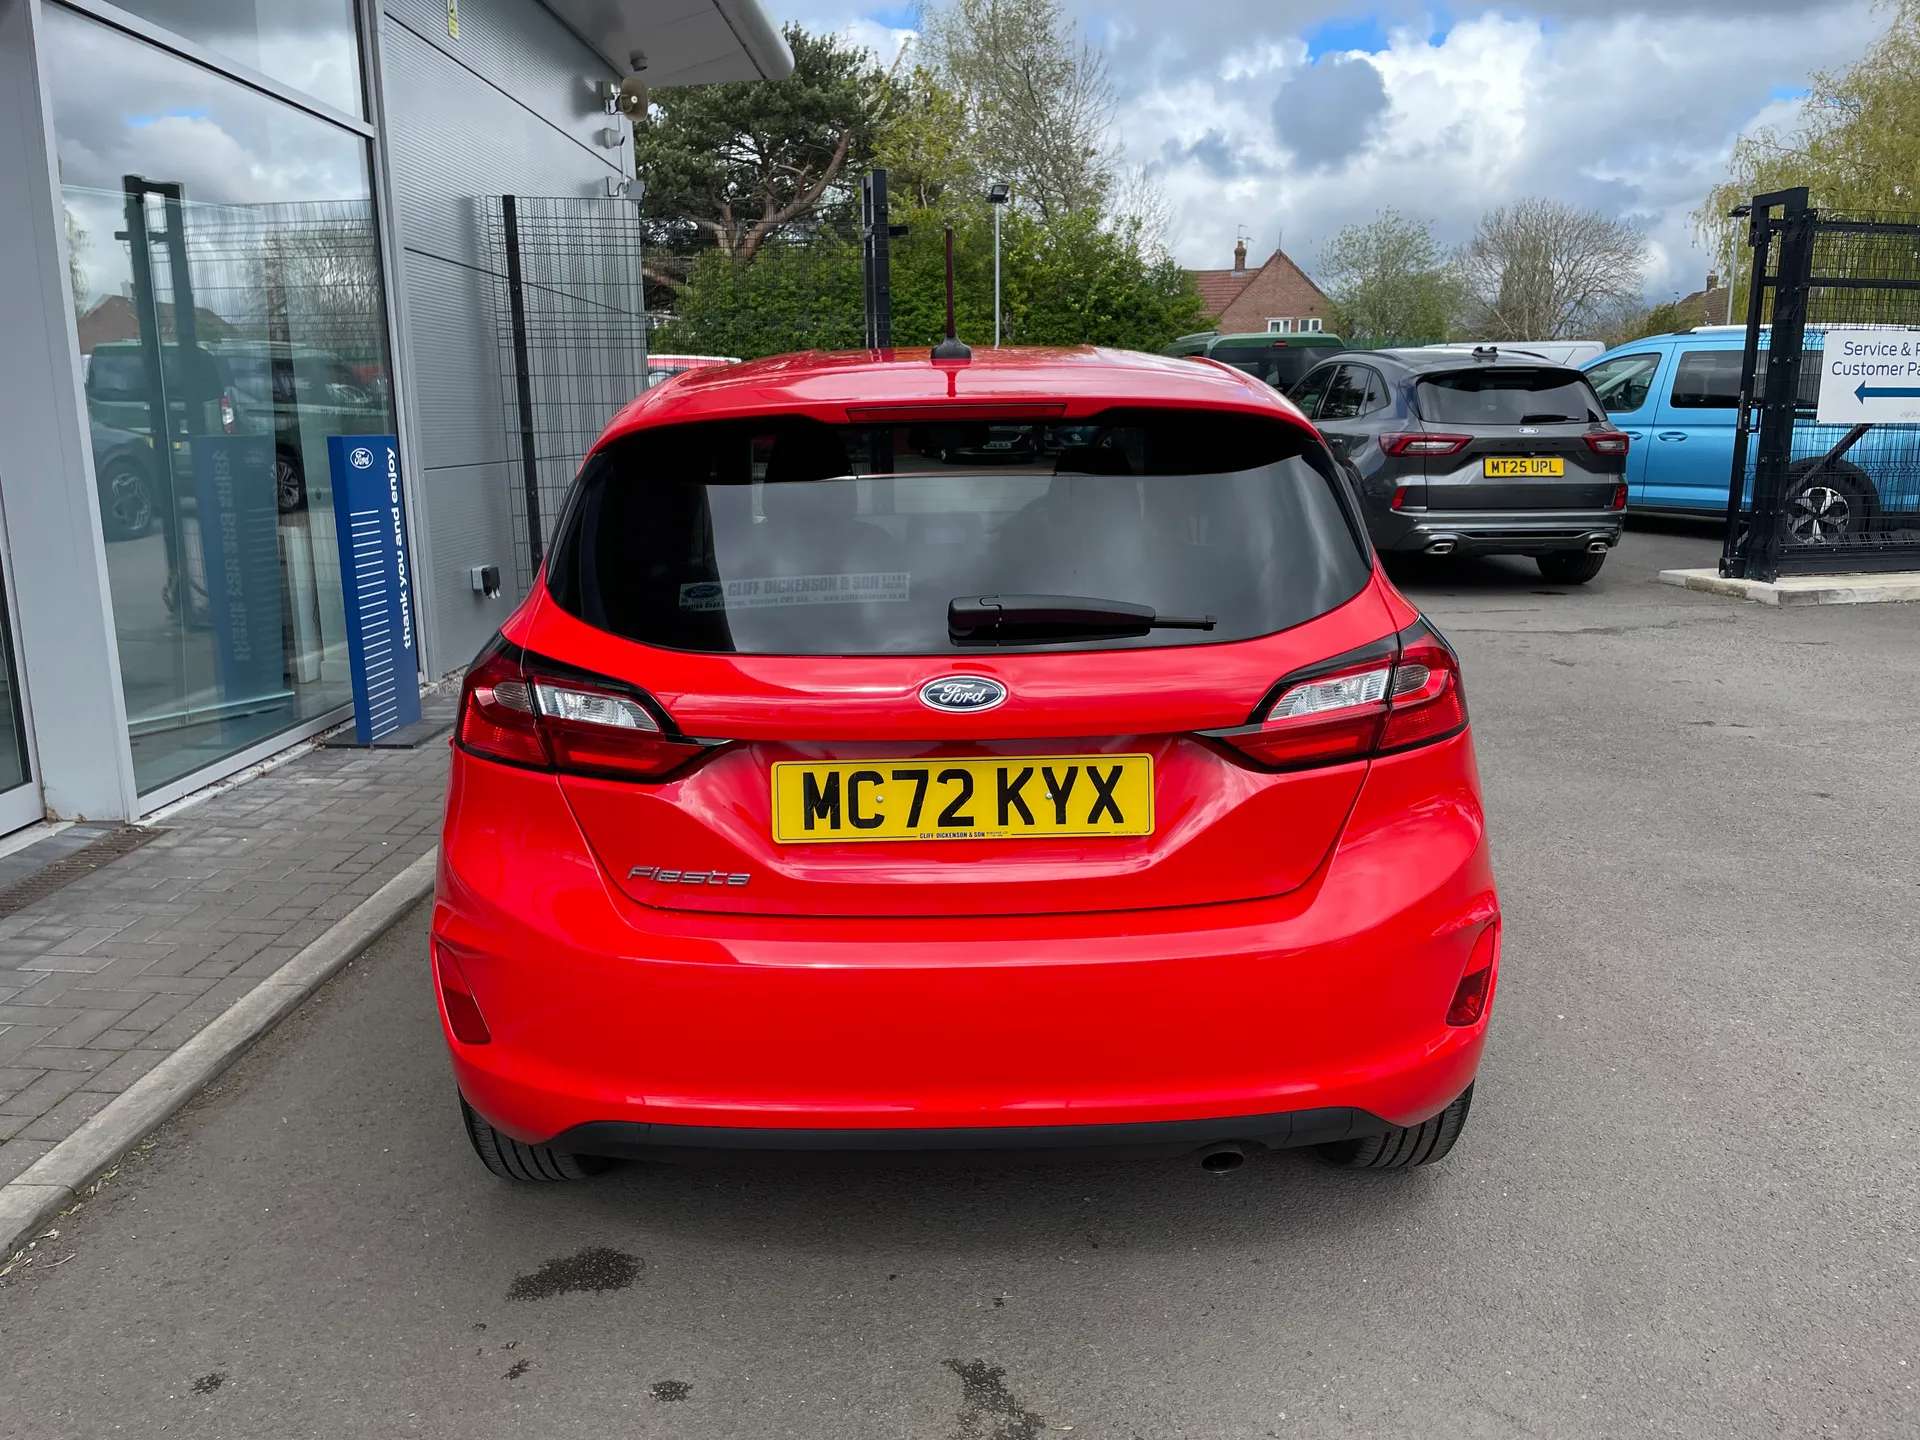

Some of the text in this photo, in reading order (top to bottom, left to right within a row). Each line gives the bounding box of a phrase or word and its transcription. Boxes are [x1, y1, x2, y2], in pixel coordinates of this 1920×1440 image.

[1843, 341, 1897, 356] Service
[1900, 342, 1911, 356] &
[1831, 361, 1904, 376] Customer
[1491, 460, 1557, 473] MT25 UPL
[386, 447, 412, 650] thank you and enjoy
[728, 580, 759, 596] CLIFF
[763, 577, 838, 595] DICKENSON
[851, 575, 879, 590] SON
[938, 683, 986, 703] Ford
[802, 765, 1125, 830] MC72 KYX
[936, 831, 968, 839] DICKENSON
[626, 865, 751, 886] Fiesta
